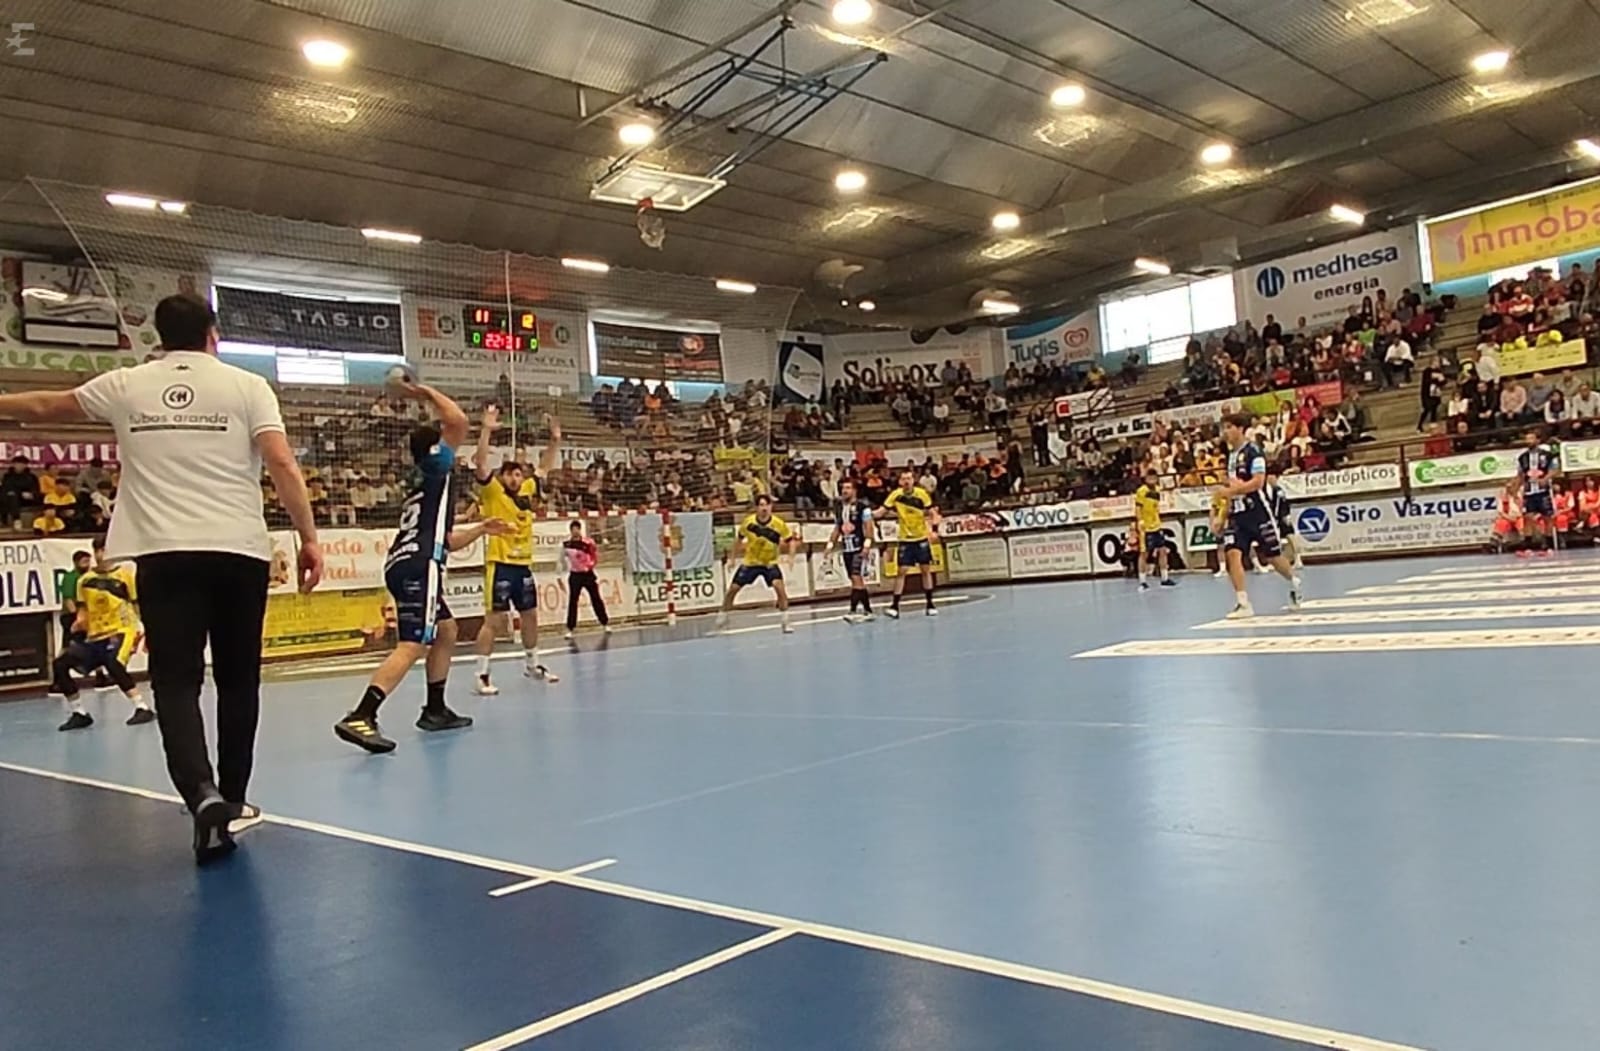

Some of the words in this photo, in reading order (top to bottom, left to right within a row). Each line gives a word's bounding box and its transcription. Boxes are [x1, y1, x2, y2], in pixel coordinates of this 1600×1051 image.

[1293, 246, 1398, 283] medhesa
[1314, 276, 1379, 300] energia
[475, 309, 489, 323] 11
[1011, 338, 1060, 363] Tudis
[1336, 505, 1381, 524] Siro
